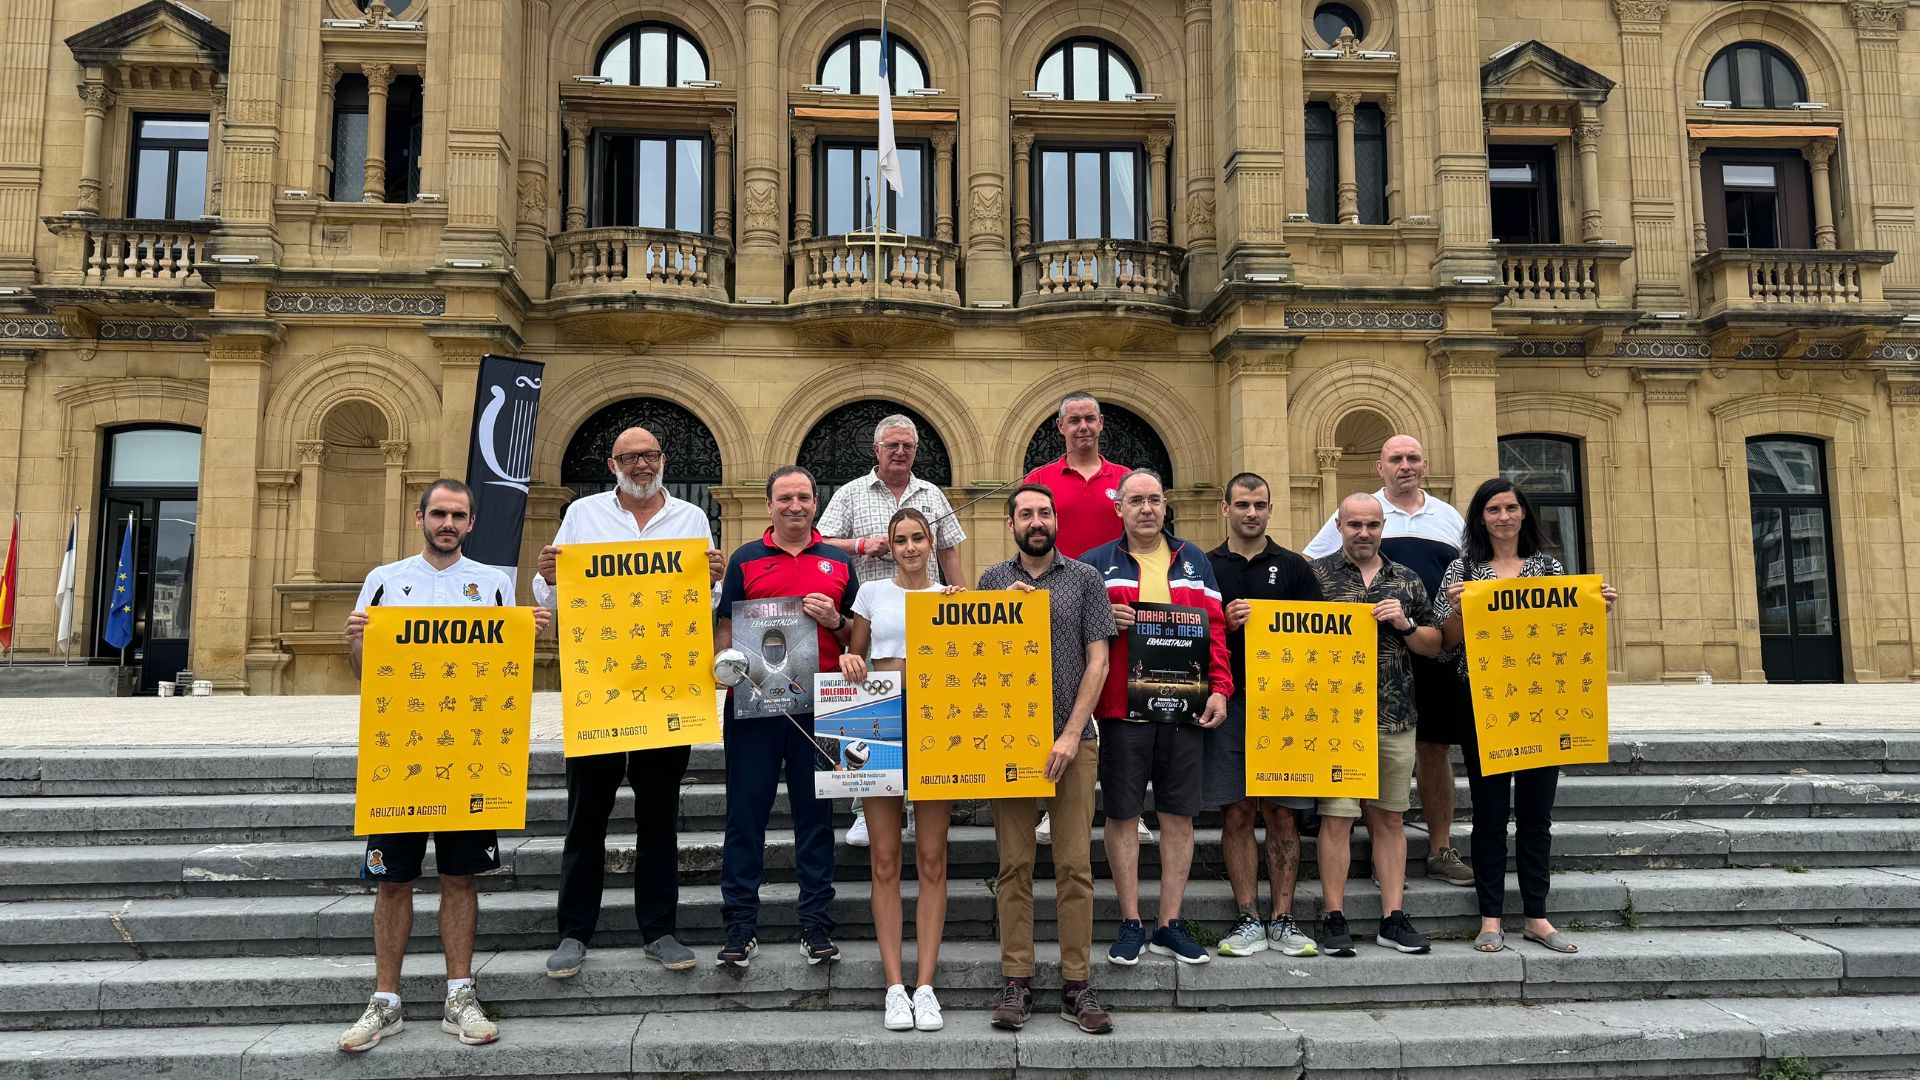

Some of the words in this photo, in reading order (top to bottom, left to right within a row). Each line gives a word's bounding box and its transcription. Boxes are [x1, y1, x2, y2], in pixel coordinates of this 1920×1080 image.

[585, 551, 683, 577] JOKOAK
[1488, 587, 1578, 611] JOKOAK
[932, 602, 1024, 625] JOKOAK
[751, 618, 799, 628] ERAKUSTALDIA
[1136, 623, 1162, 635] TENIS
[1165, 627, 1174, 636] de
[1177, 625, 1204, 638] MESA
[1269, 612, 1352, 635] JOKOAK
[395, 620, 505, 644] JOKOAK
[1146, 637, 1193, 647] ERAKUSTALDIA
[820, 688, 857, 696] BOLEIBOLA
[577, 729, 610, 740] ABUZTUA
[612, 728, 618, 737] 3
[620, 725, 648, 736] AGOSTO
[1489, 748, 1513, 760] ABUZTUA
[1514, 747, 1519, 756] 3
[1520, 744, 1542, 755] AGOSTO
[920, 775, 950, 785] ABUZTUA
[952, 774, 959, 784] 3
[960, 774, 986, 784] AGOSTO
[1256, 772, 1283, 782] ABUZTUA
[1284, 773, 1289, 781] 3
[1290, 773, 1314, 782] AGOSTO
[370, 806, 406, 818] ABUZTUA
[407, 805, 414, 816] 3
[417, 805, 447, 816] AGOSTO
